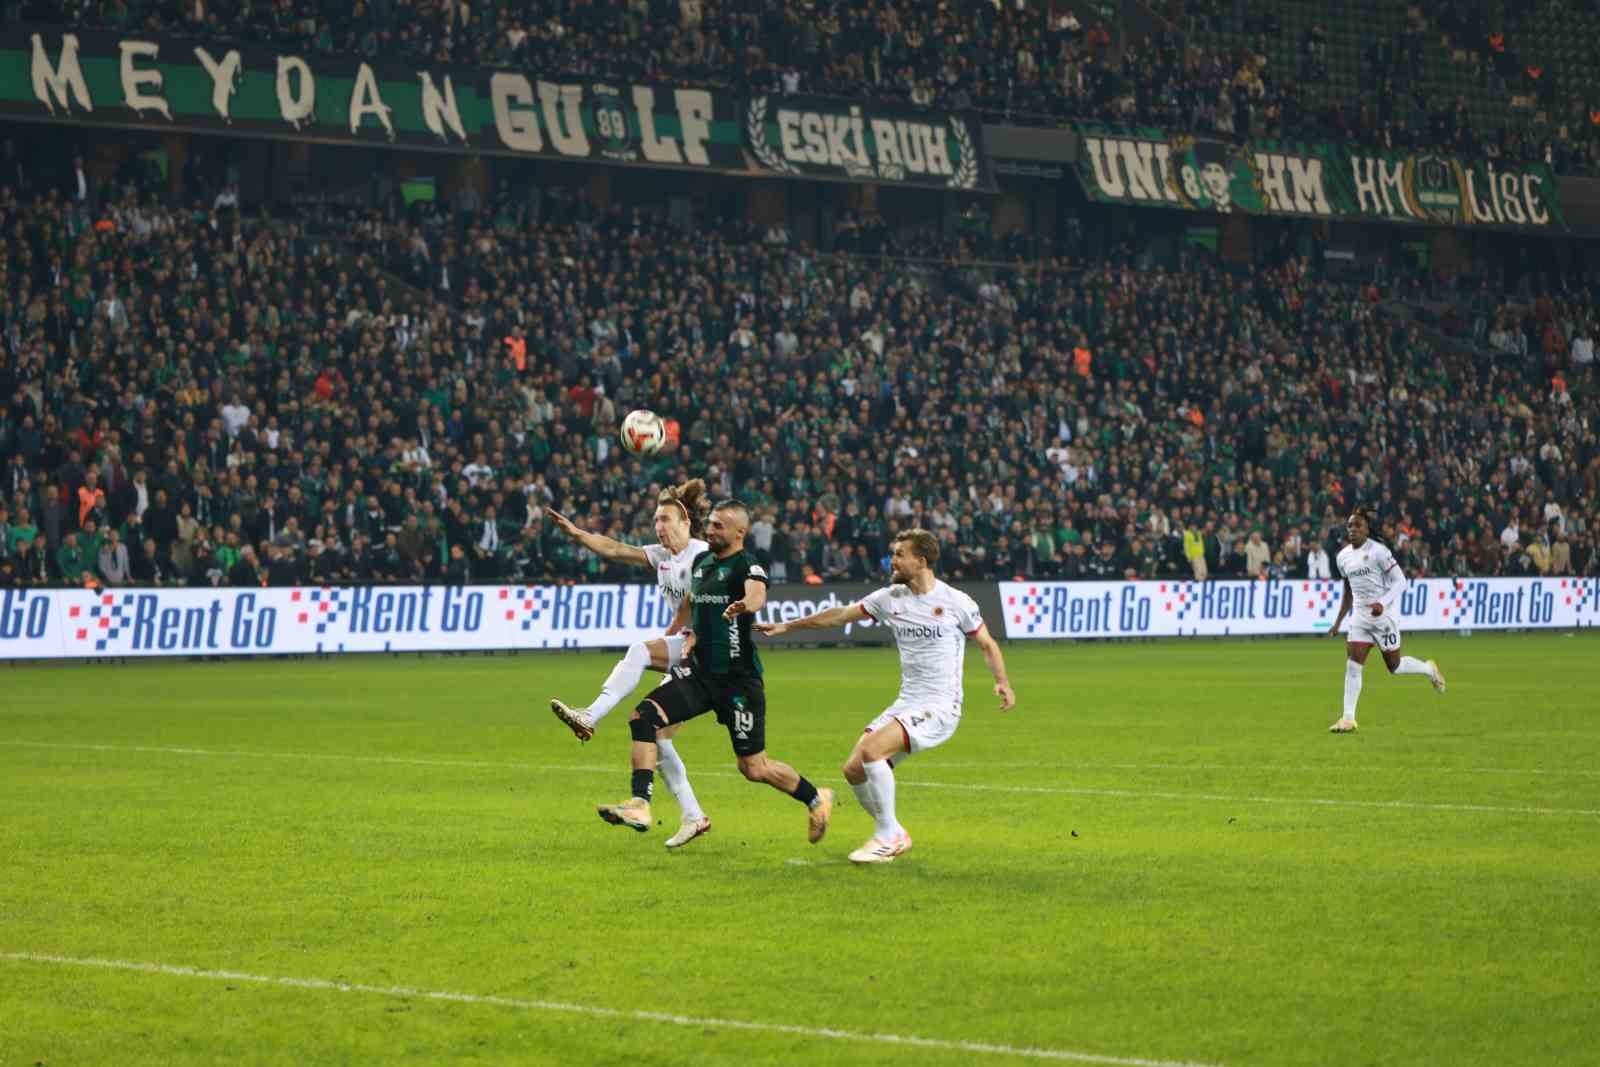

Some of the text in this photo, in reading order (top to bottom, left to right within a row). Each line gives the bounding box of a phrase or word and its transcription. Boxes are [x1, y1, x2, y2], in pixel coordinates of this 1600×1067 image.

[31, 33, 470, 143] MEYDAN
[777, 106, 870, 167] ESKİ
[1255, 153, 1330, 215] HM
[132, 593, 278, 649] Rent Go
[348, 586, 484, 633] Rent Go
[551, 585, 626, 630] Rent
[1051, 585, 1151, 633] Rent Go
[1200, 580, 1293, 619] Rent Go
[1473, 582, 1554, 624] Rent Go
[1382, 633, 1397, 647] 70
[734, 710, 754, 731] 19
